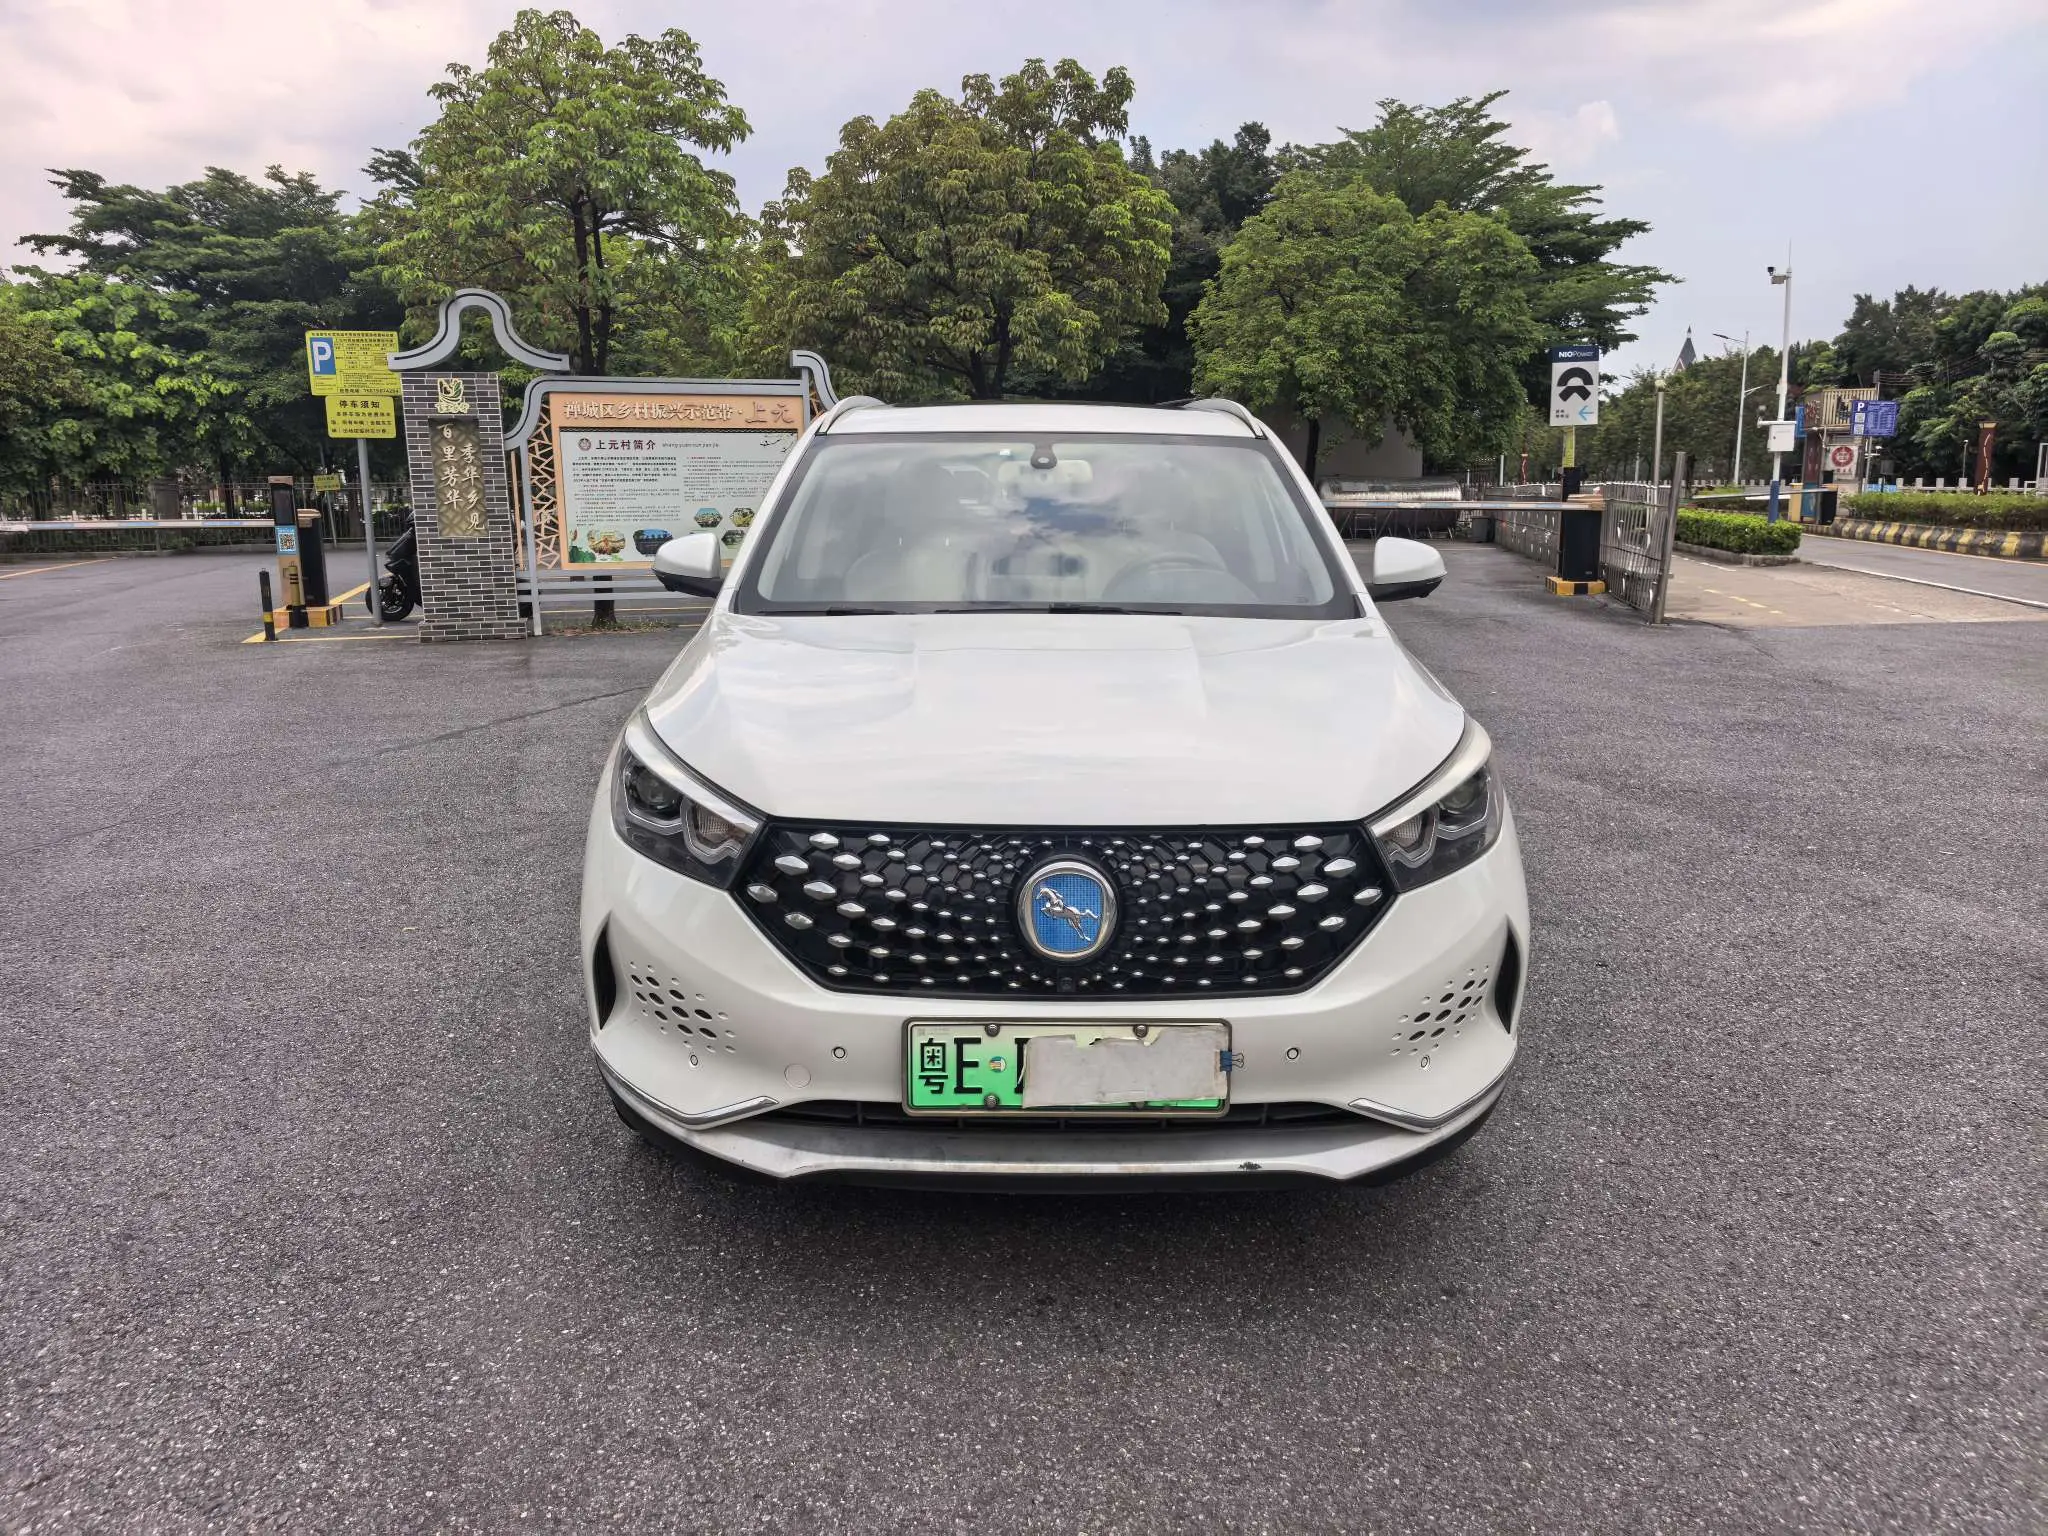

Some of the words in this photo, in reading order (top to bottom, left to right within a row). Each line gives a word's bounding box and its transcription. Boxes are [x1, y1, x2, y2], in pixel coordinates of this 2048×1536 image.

[312, 341, 332, 372] P
[1857, 402, 1865, 412] P
[595, 439, 656, 450] 上元村简介
[437, 423, 463, 509] 百里芳华
